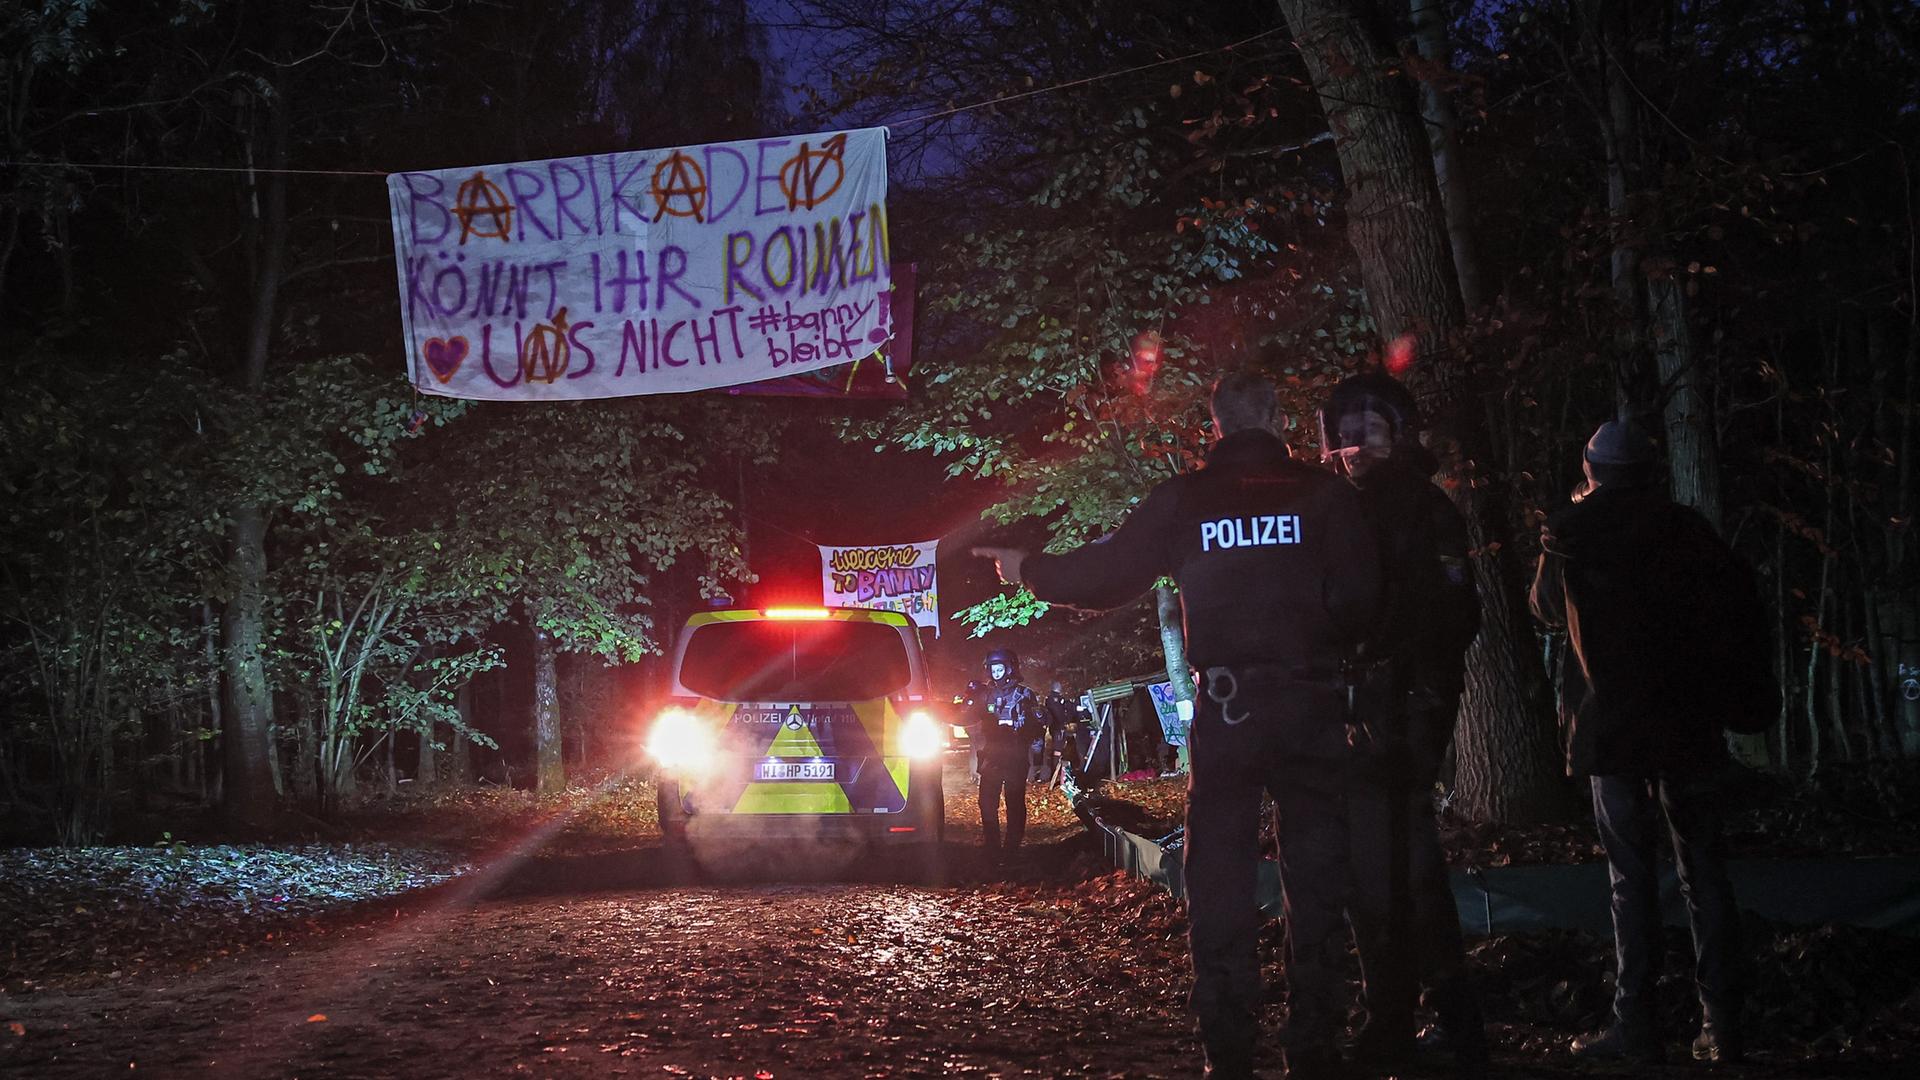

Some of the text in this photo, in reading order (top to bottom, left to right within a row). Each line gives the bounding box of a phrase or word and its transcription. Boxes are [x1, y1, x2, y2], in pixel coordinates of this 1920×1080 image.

[405, 132, 846, 244] BARRIKADEN
[406, 252, 567, 320] KÖNNT
[592, 245, 701, 315] IHR
[482, 306, 744, 388] UNS NICHT
[1201, 515, 1301, 552] POLIZEI
[832, 564, 936, 603] TO BANNY
[735, 712, 782, 724] POLIZEI
[786, 765, 801, 778] HP
[804, 765, 833, 778] 5191
